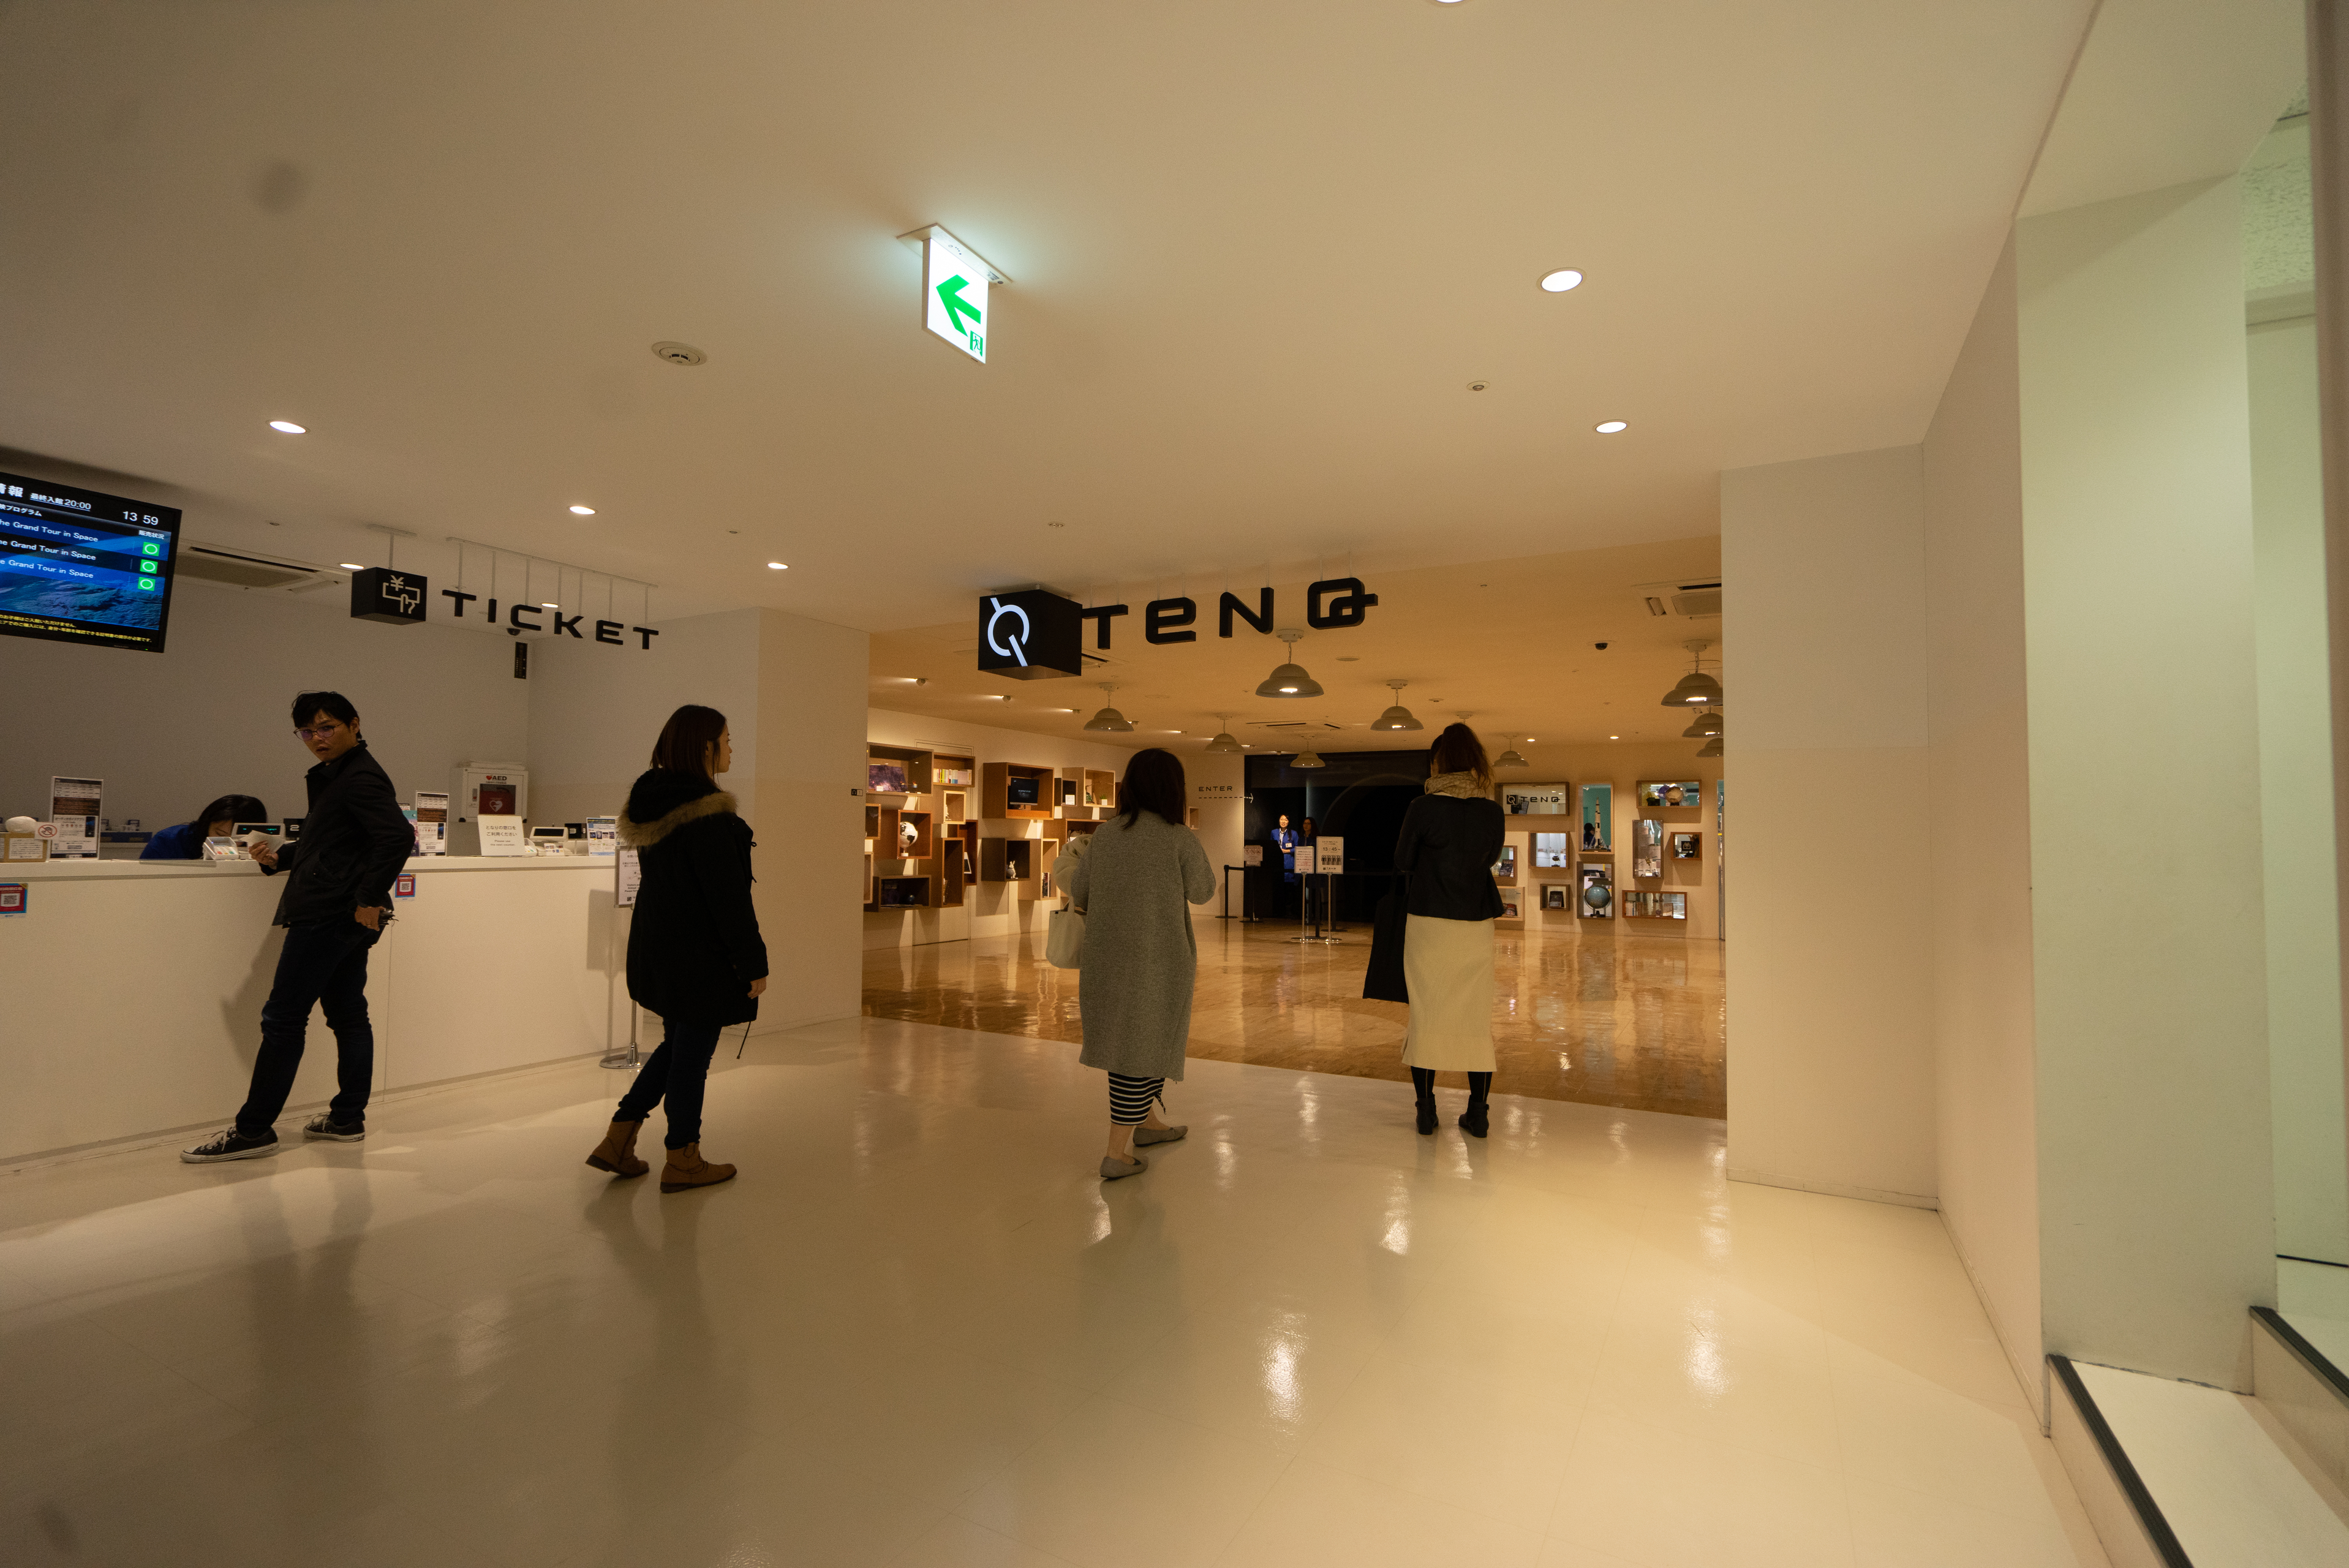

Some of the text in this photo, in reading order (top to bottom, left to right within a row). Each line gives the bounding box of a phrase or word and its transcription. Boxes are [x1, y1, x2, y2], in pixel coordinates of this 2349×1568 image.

[123, 511, 159, 526] 13 59
[13, 521, 39, 532] Grand
[41, 526, 61, 535] Tour
[73, 532, 98, 542] Space
[10, 540, 37, 551] Grand
[39, 545, 59, 554] Tour
[70, 551, 96, 560] Space
[8, 559, 34, 569] Grand
[37, 564, 57, 573] Tour
[69, 569, 94, 578] Space
[442, 589, 659, 650] TICKET
